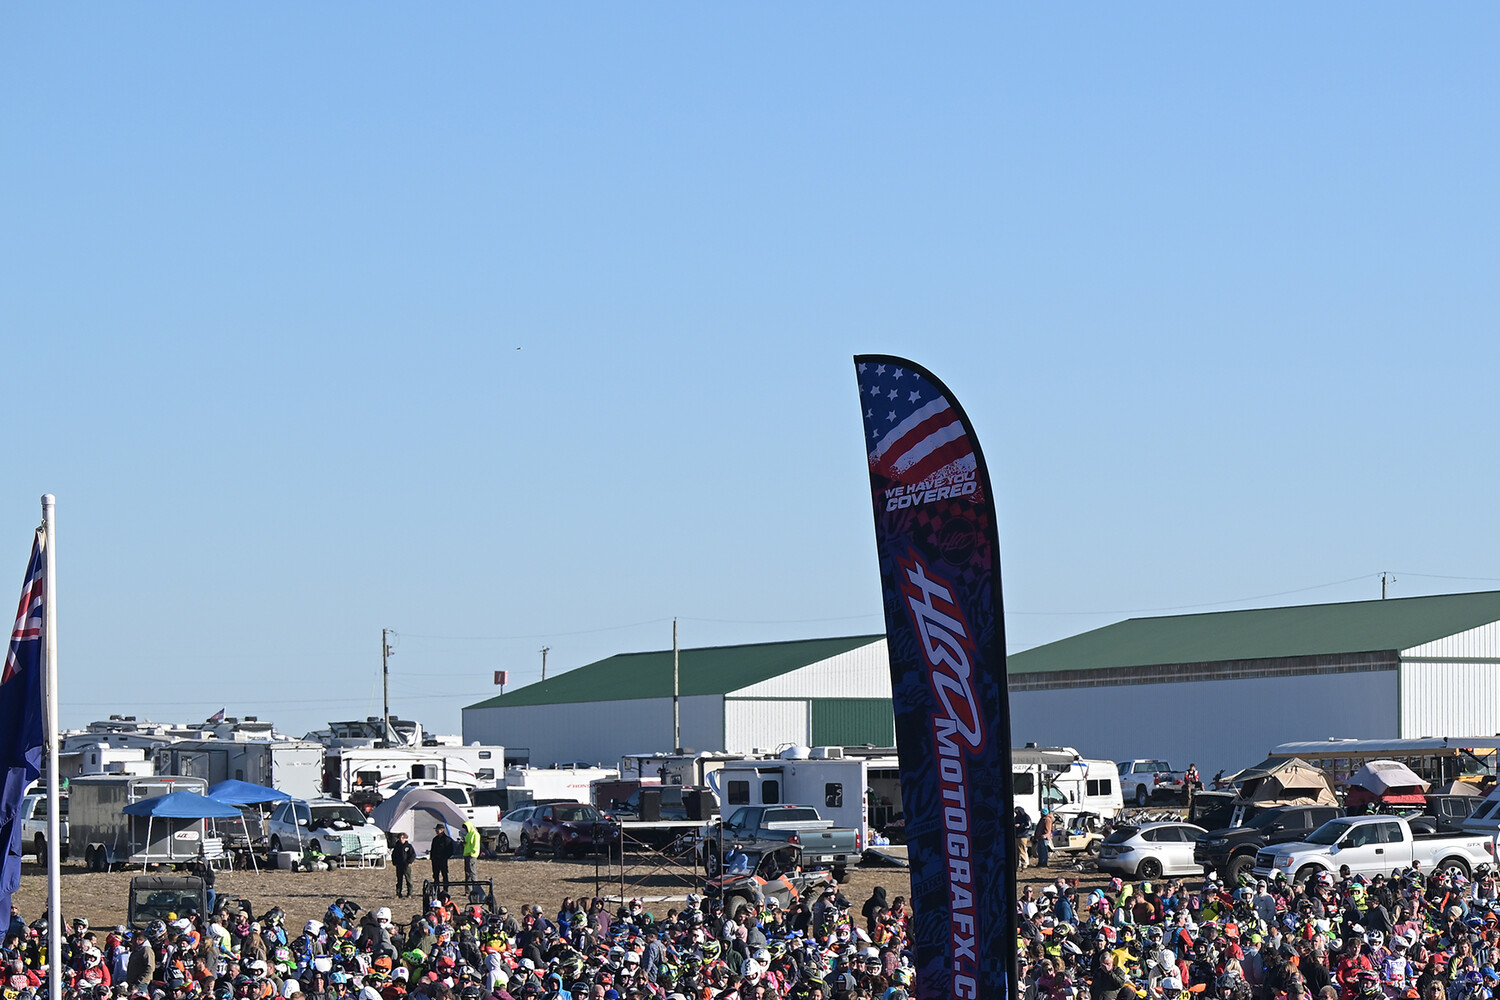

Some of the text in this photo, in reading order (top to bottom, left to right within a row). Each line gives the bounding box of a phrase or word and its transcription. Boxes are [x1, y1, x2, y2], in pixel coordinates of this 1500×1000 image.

[885, 472, 975, 498] WE HAVE YOU
[886, 481, 977, 512] COVERED
[7, 992, 17, 1000] 62
[1182, 992, 1189, 1000] 14
